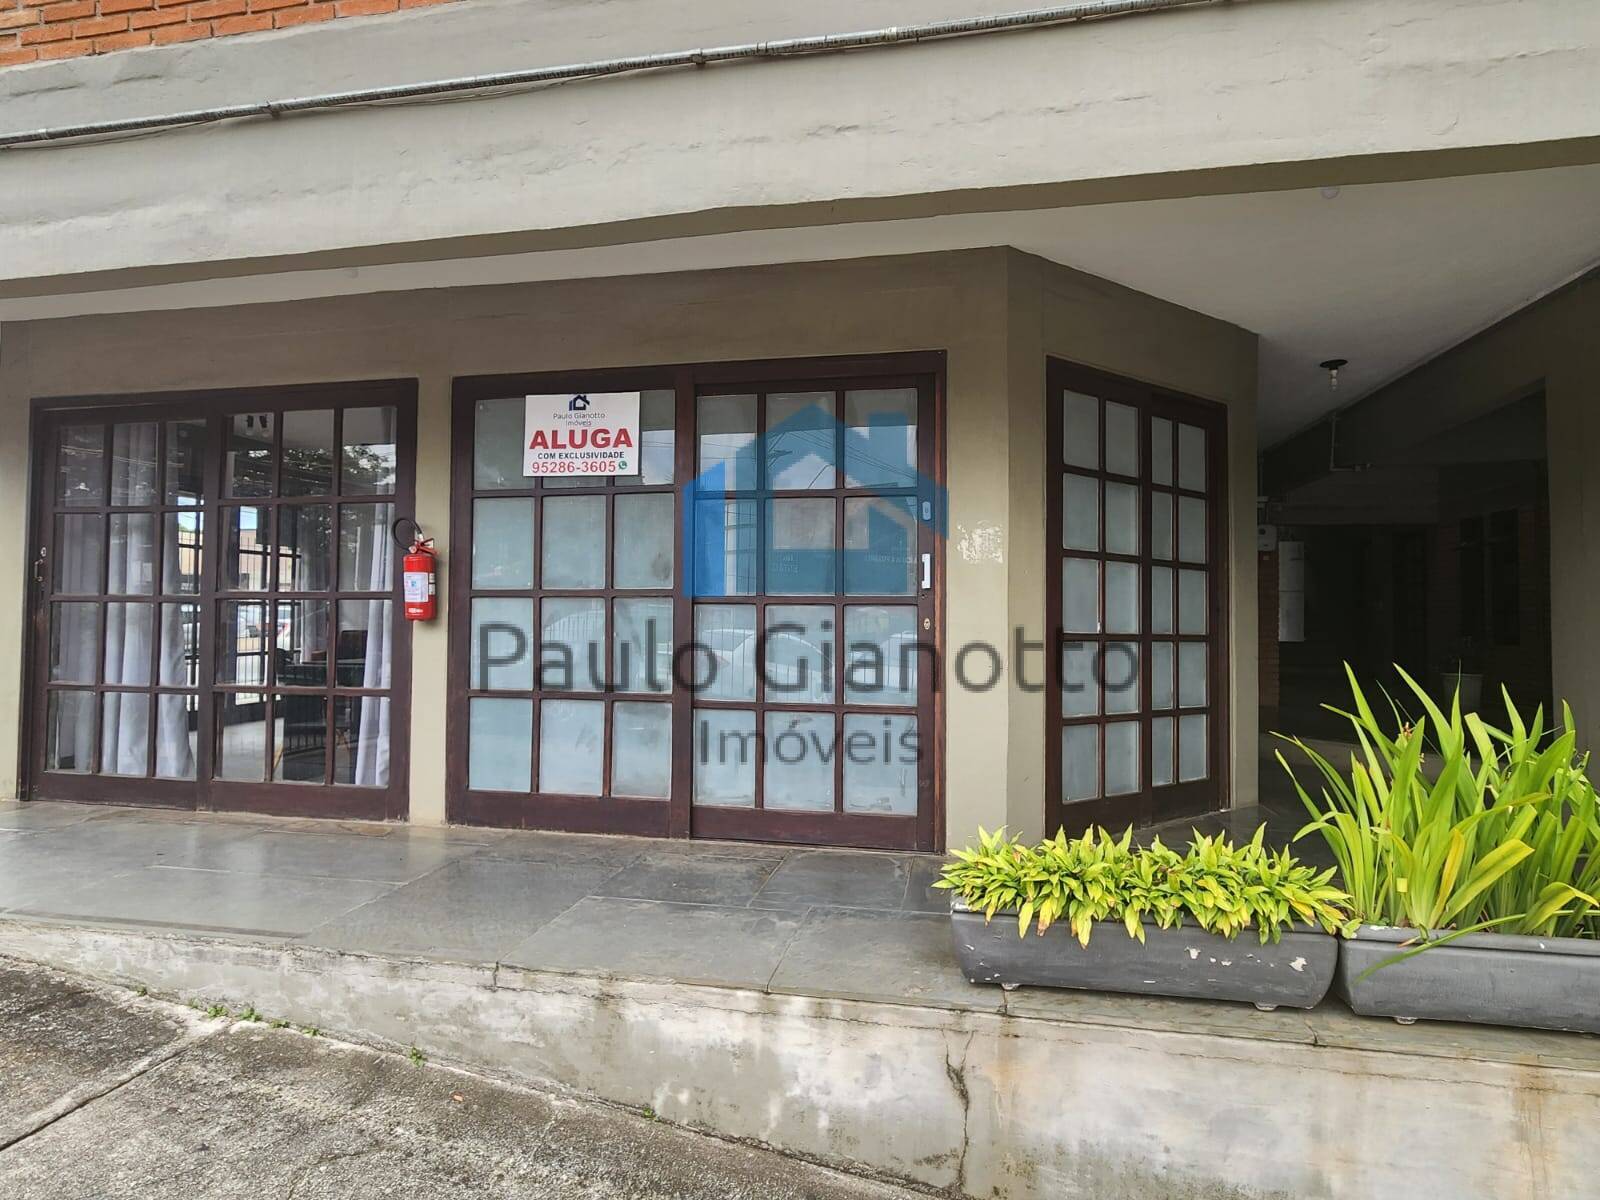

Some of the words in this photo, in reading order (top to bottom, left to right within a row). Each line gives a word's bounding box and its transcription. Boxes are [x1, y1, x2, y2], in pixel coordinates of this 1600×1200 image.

[574, 411, 606, 419] Gianotto
[529, 428, 632, 450] ALUGA
[558, 451, 625, 459] EXCLUSIVIDADE
[532, 460, 616, 473] 95286-3605
